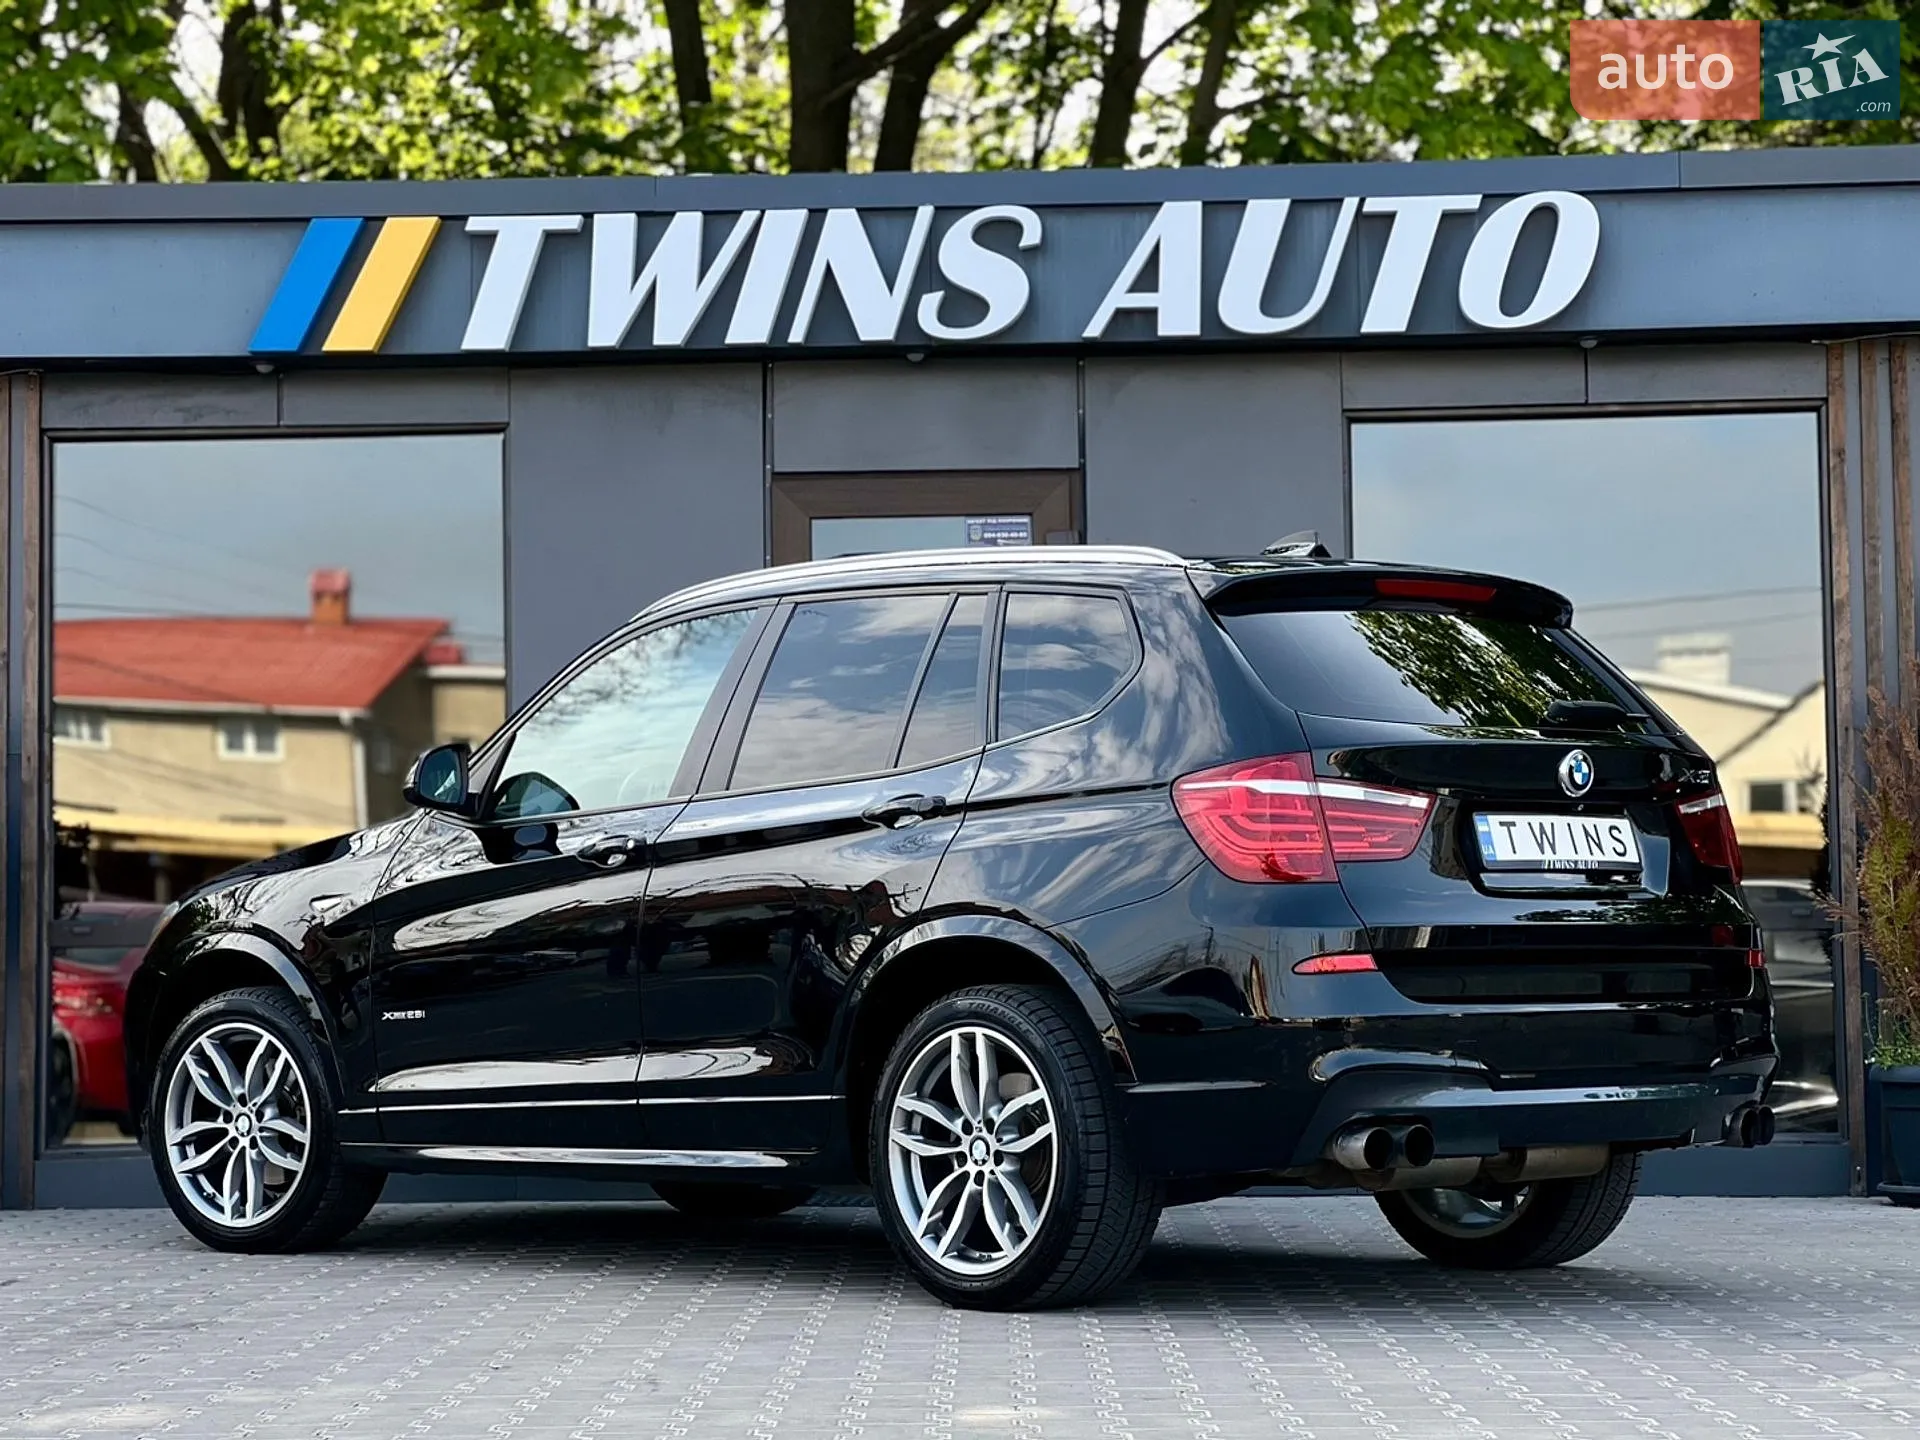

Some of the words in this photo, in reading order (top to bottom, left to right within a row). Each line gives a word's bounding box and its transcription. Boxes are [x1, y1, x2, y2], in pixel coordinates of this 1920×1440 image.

[461, 205, 1043, 351] TWINS
[1082, 190, 1600, 338] AUTO
[1499, 821, 1628, 857] TWINS
[1550, 860, 1575, 869] TWINS
[1577, 860, 1600, 869] AUTO
